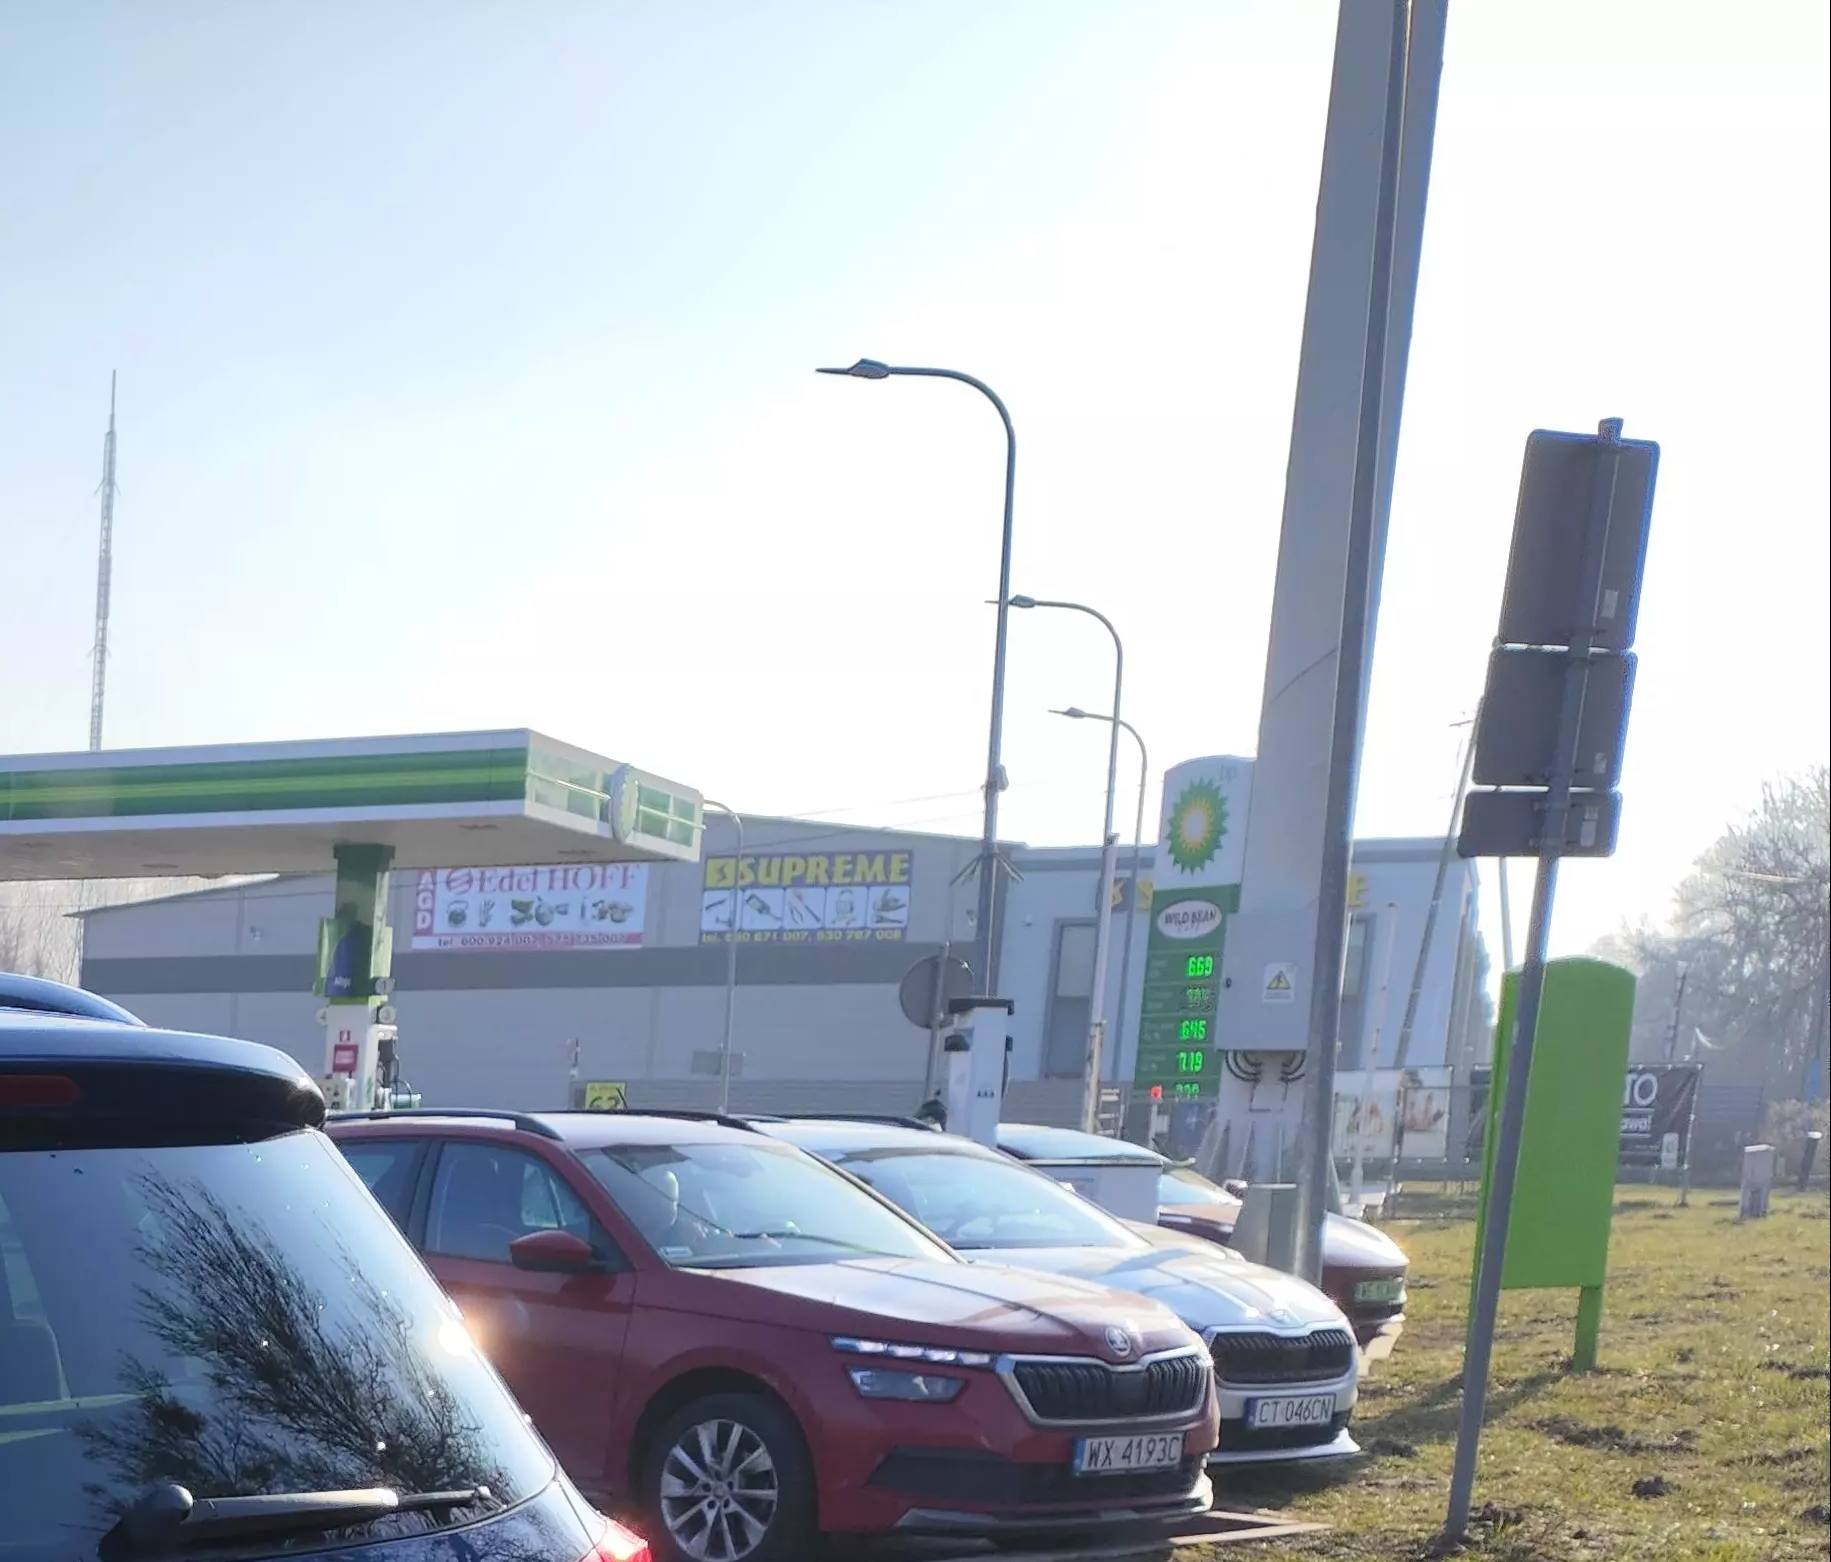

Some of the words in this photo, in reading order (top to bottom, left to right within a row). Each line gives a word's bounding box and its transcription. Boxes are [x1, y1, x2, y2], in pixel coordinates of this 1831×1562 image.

[478, 868, 538, 893] Edel
[547, 864, 636, 892] HOFF
[738, 853, 909, 885] SUPREME
[416, 870, 435, 930] AGD
[1164, 911, 1189, 925] WILD
[1191, 909, 1217, 923] BEAN
[1259, 1401, 1281, 1424] CT
[1284, 1399, 1331, 1424] 046CN
[1087, 1439, 1116, 1469] WX
[1121, 1435, 1180, 1466] 4193C
